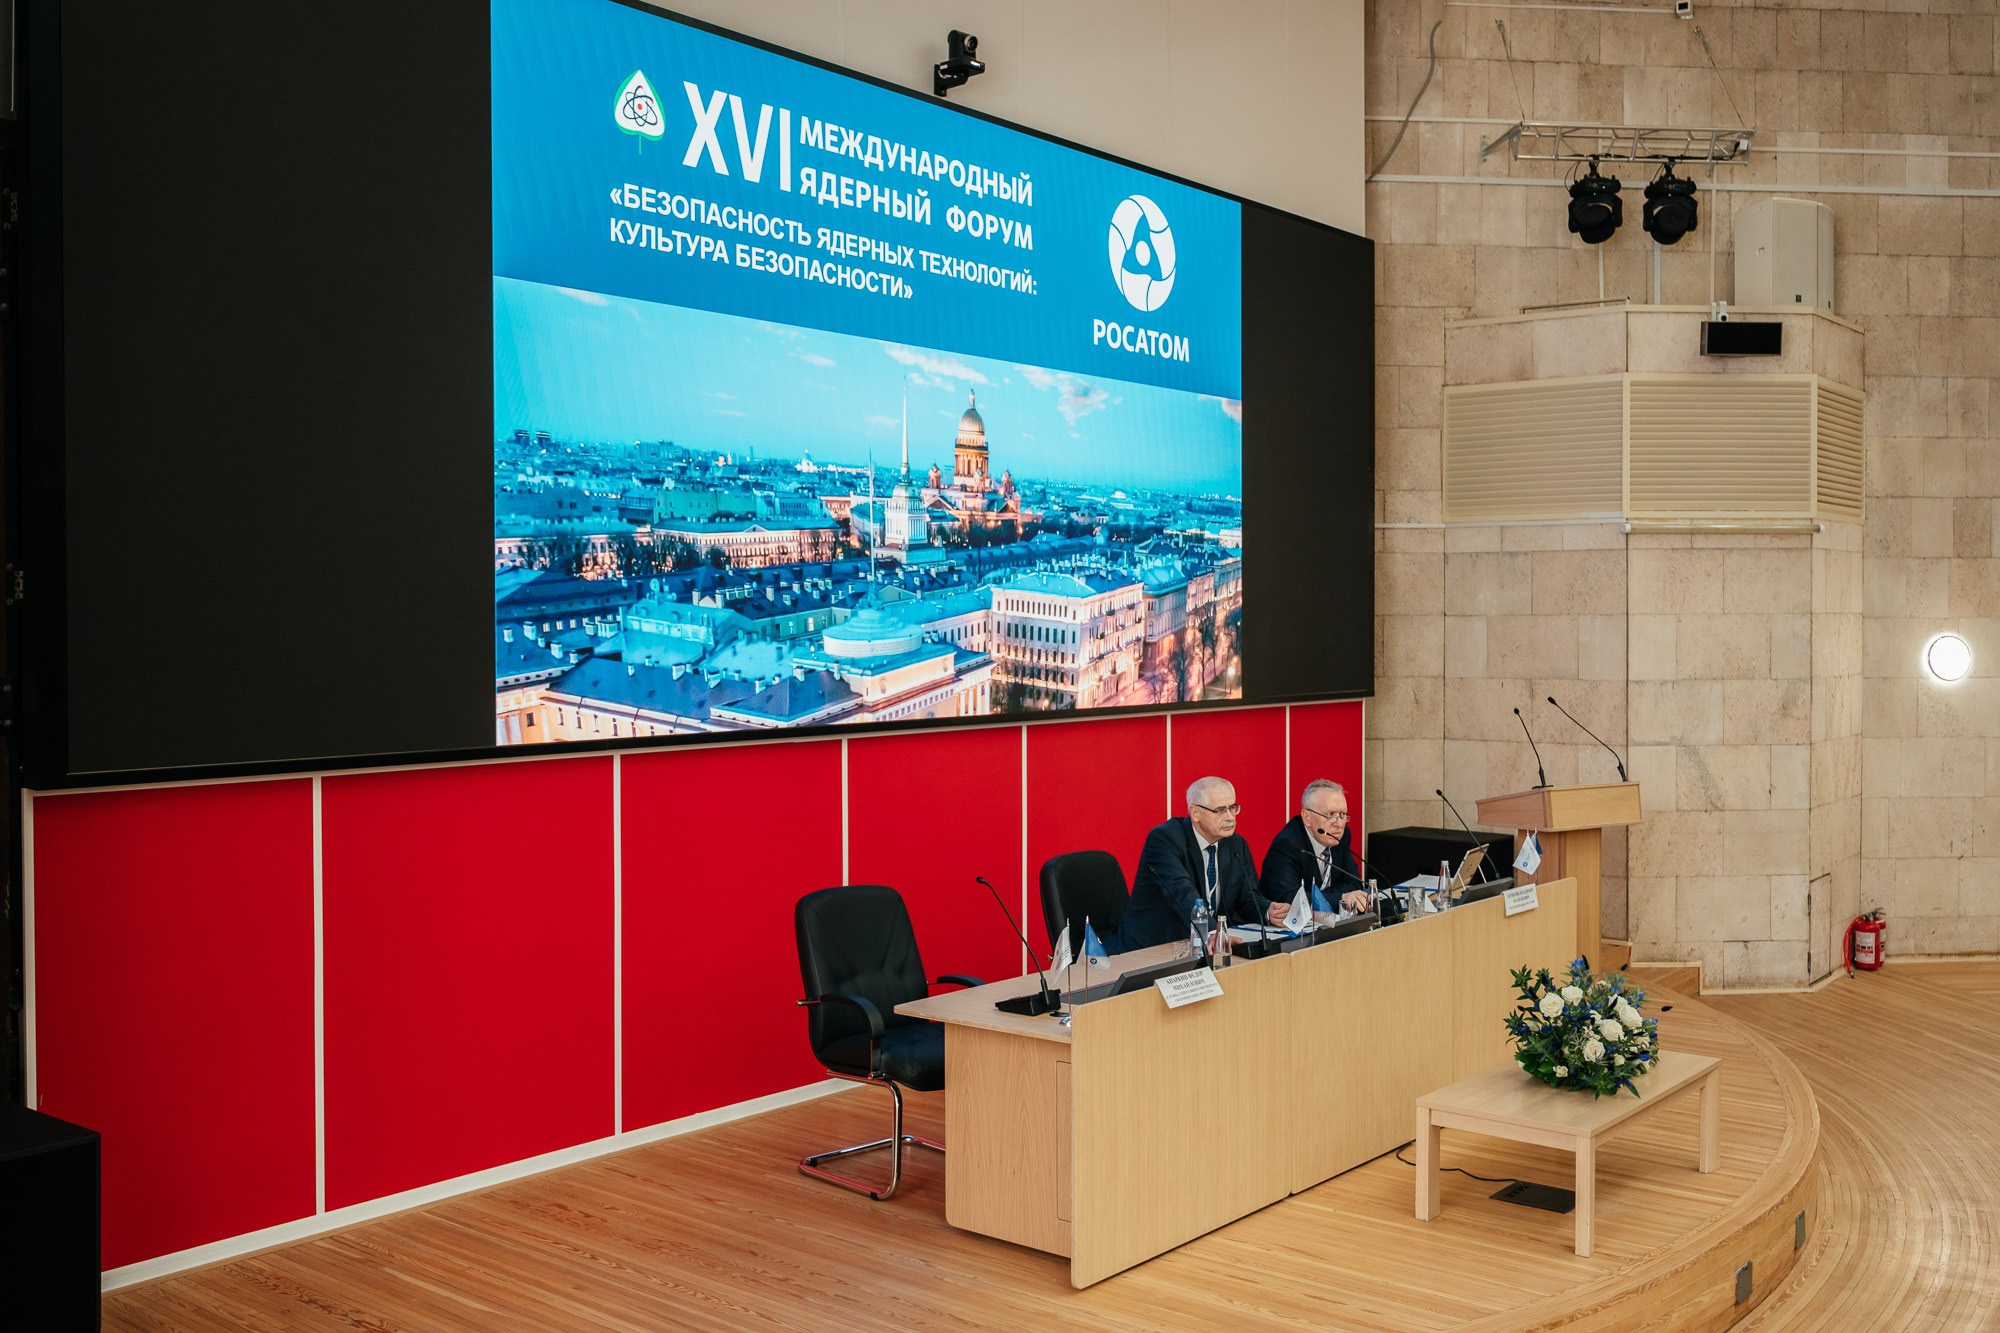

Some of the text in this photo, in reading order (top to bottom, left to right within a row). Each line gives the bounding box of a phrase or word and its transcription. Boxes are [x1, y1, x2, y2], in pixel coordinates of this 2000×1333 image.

[683, 81, 792, 193] XVI
[800, 116, 1033, 207] МЕЖДУНАРОДНЫЙ
[610, 183, 1037, 296] «БЕЗОПАСНОСТЬ ЯДЕРНЫХ ТЕХНОЛОГИЙ:
[800, 167, 1033, 251] ЯДЕРНЫЙ ФОРУМ
[611, 218, 913, 299] КУЛЬТУРА БЕЗОПАСНОСТИ»
[1094, 319, 1190, 363] РОСАТОМ
